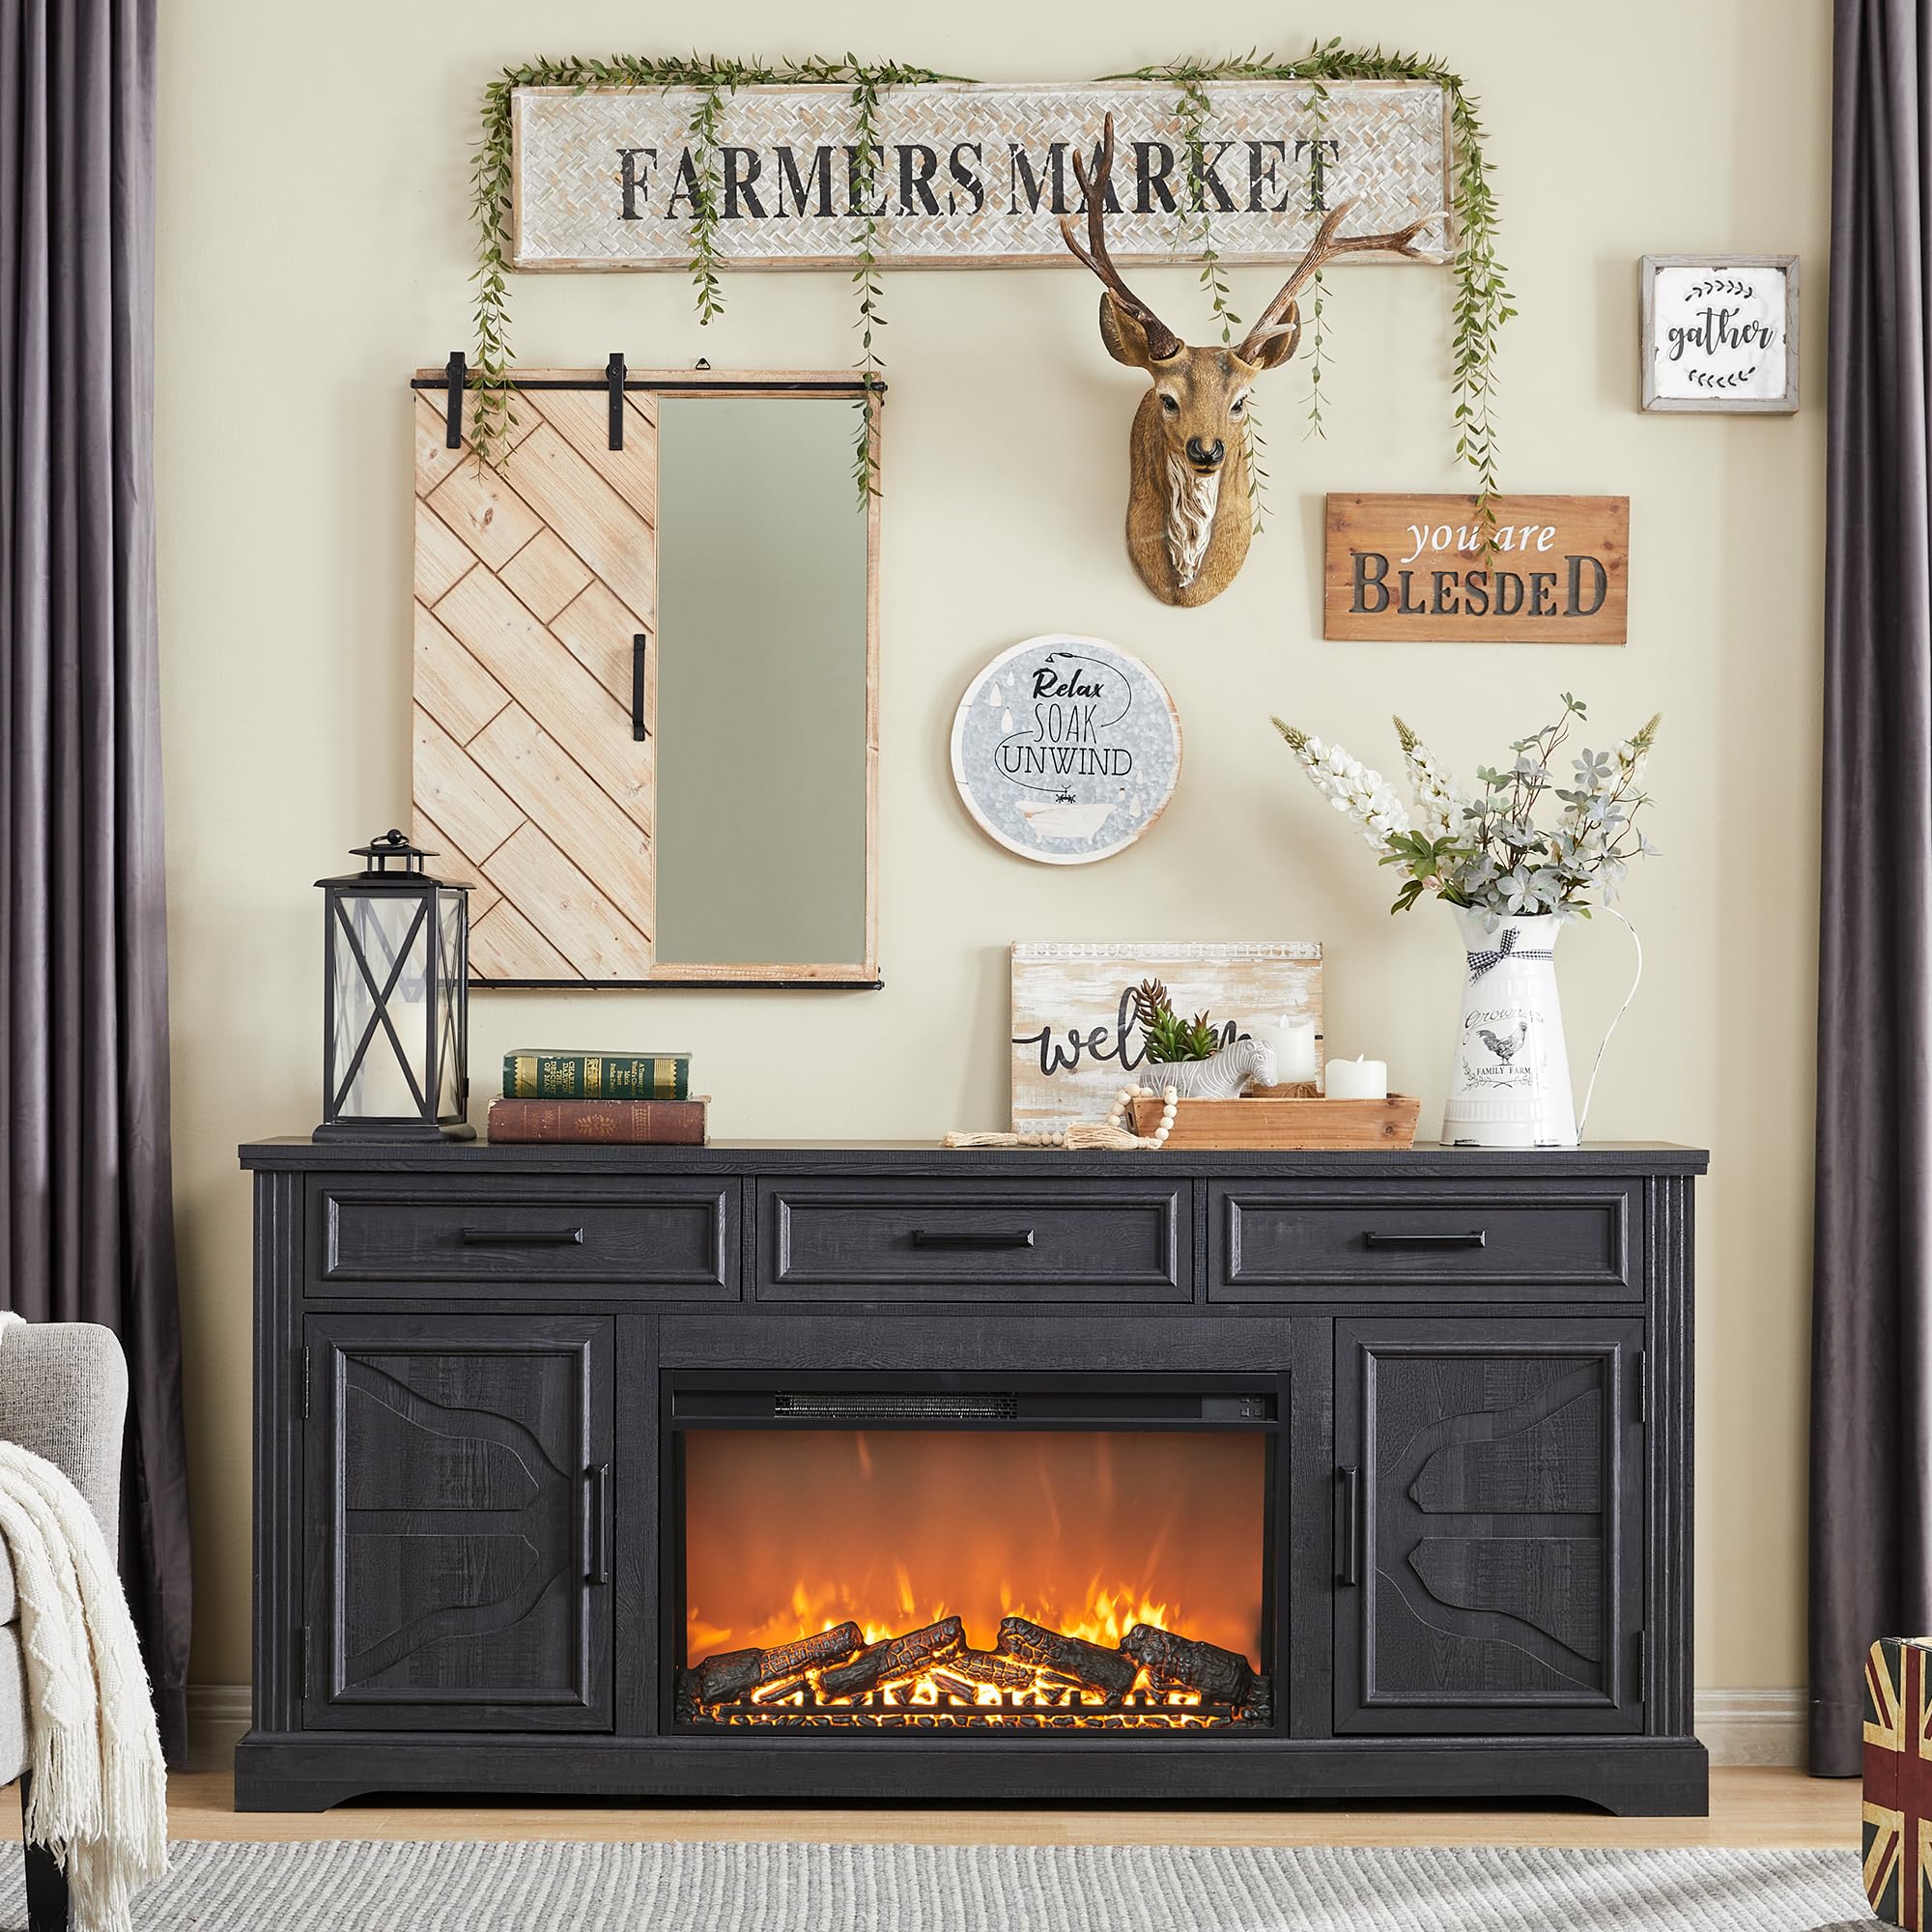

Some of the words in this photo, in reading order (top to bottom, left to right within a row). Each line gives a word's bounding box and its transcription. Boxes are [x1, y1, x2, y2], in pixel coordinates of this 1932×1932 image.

[616, 143, 984, 220] FARMERS
[1010, 140, 1340, 215] MARKET
[1668, 307, 1774, 361] gather
[1401, 524, 1480, 563] you
[1494, 525, 1556, 552] are
[1348, 552, 1608, 618] BLESDED
[1032, 668, 1105, 699] Relax
[1033, 702, 1097, 744] SOAK
[1002, 745, 1133, 776] UNWIND
[1476, 1066, 1506, 1076] FAMILY
[1509, 1066, 1531, 1075] FARM
